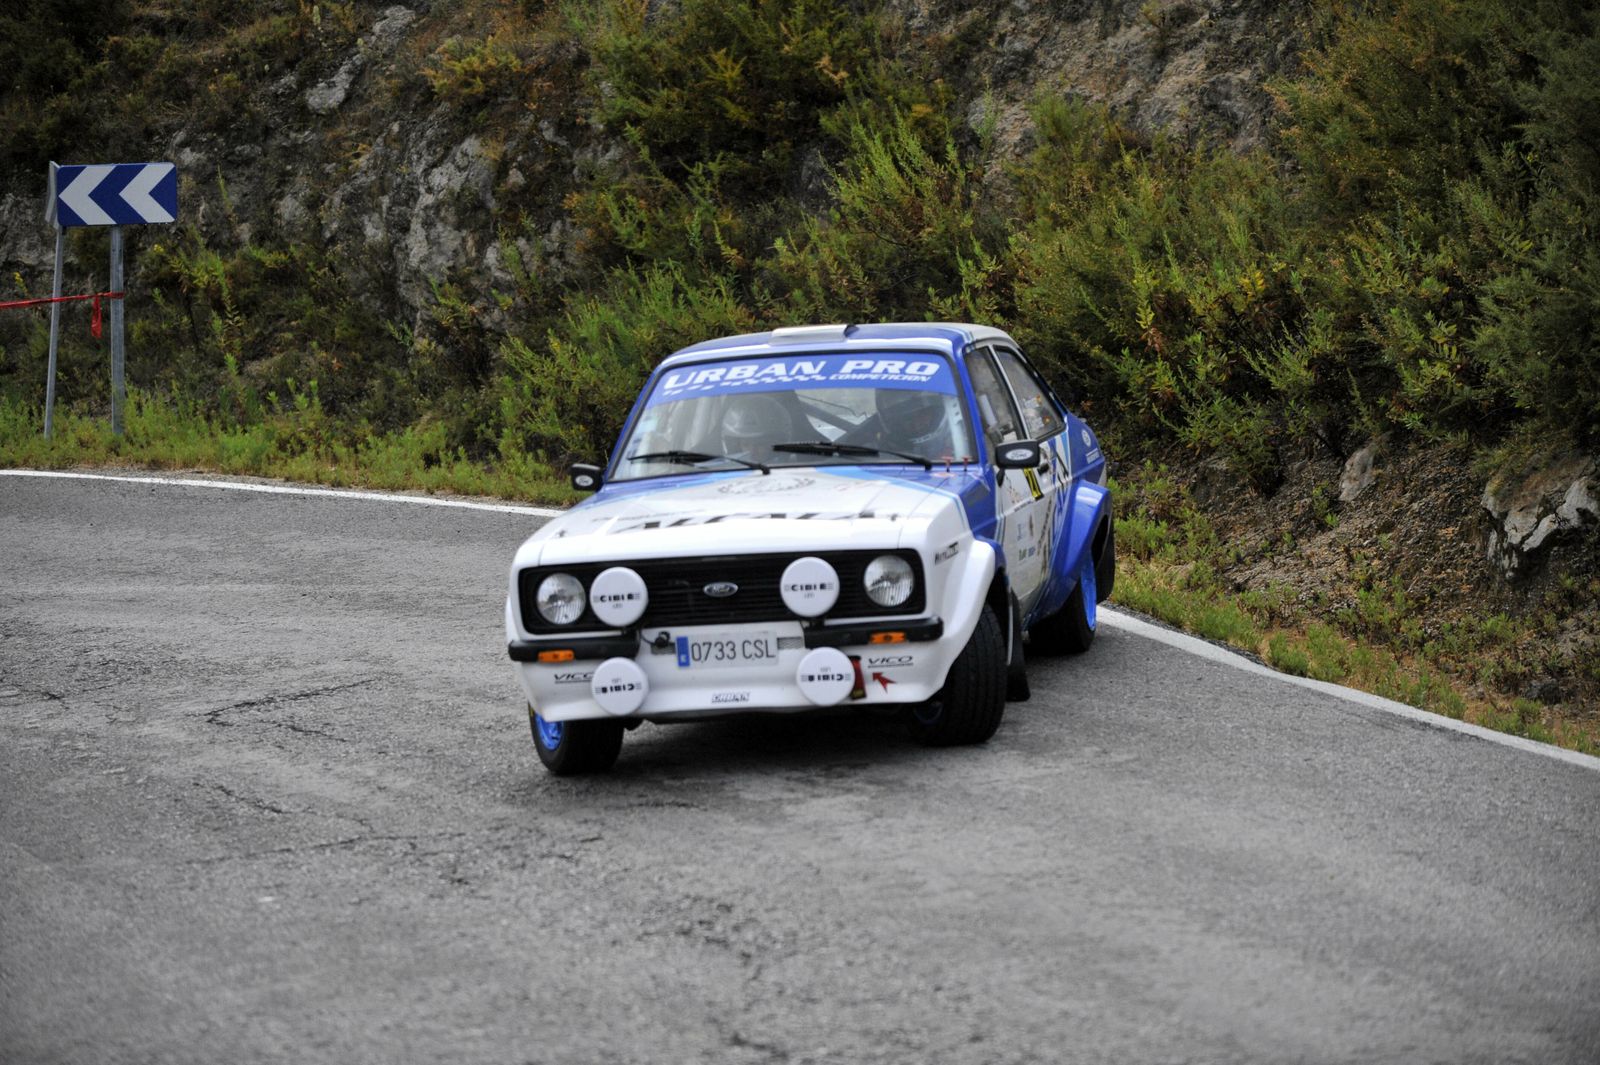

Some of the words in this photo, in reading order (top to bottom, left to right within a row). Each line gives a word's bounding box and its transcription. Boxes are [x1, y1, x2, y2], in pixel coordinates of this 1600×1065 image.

[663, 360, 827, 390] URBAN
[839, 360, 940, 376] PRO
[691, 640, 737, 662] 0733
[742, 639, 777, 660] CSL
[868, 655, 913, 664] VICO
